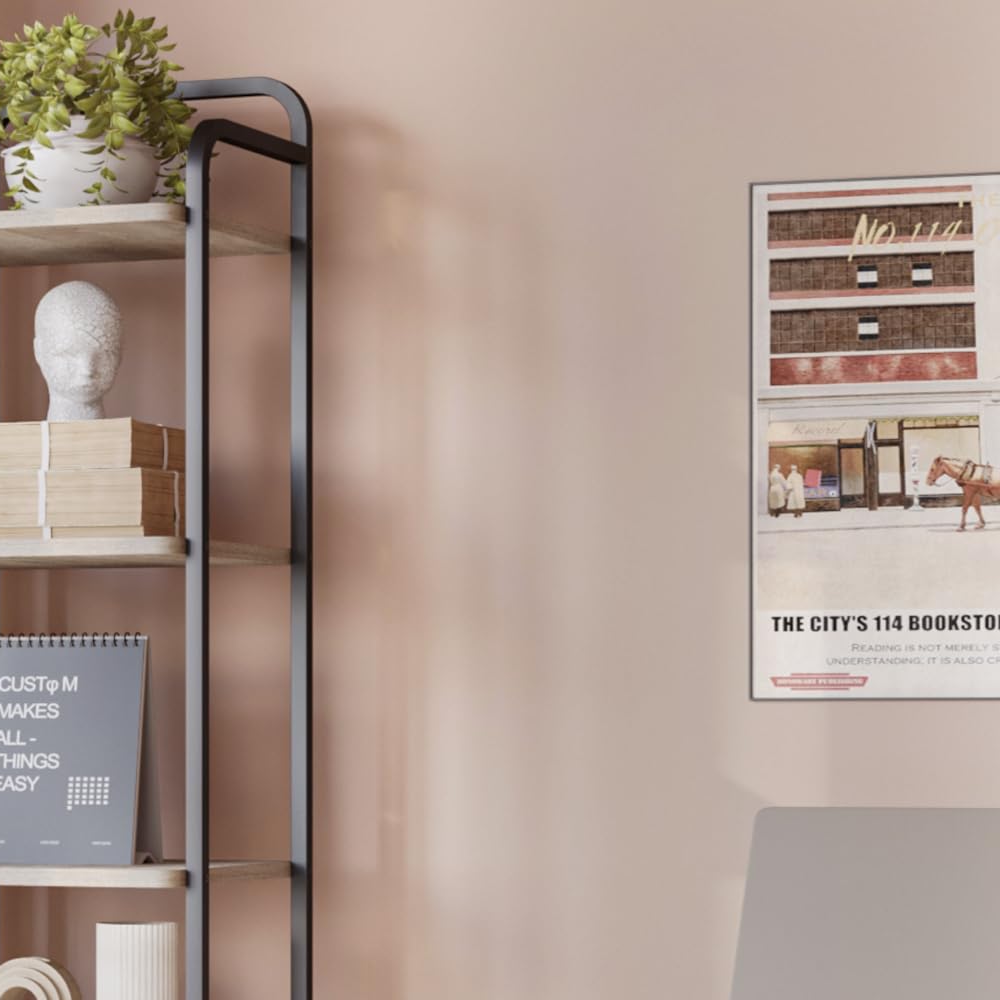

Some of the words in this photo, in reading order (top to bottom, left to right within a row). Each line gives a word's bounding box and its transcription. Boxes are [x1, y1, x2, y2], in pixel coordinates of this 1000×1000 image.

[771, 615, 805, 632] THE
[810, 615, 868, 632] CITY'S
[873, 615, 903, 632] 114
[851, 643, 901, 653] READING
[905, 644, 916, 653] IS
[919, 644, 941, 653] NOT
[928, 656, 937, 665] IT
[940, 656, 951, 665] IS
[954, 655, 985, 665] ALSO
